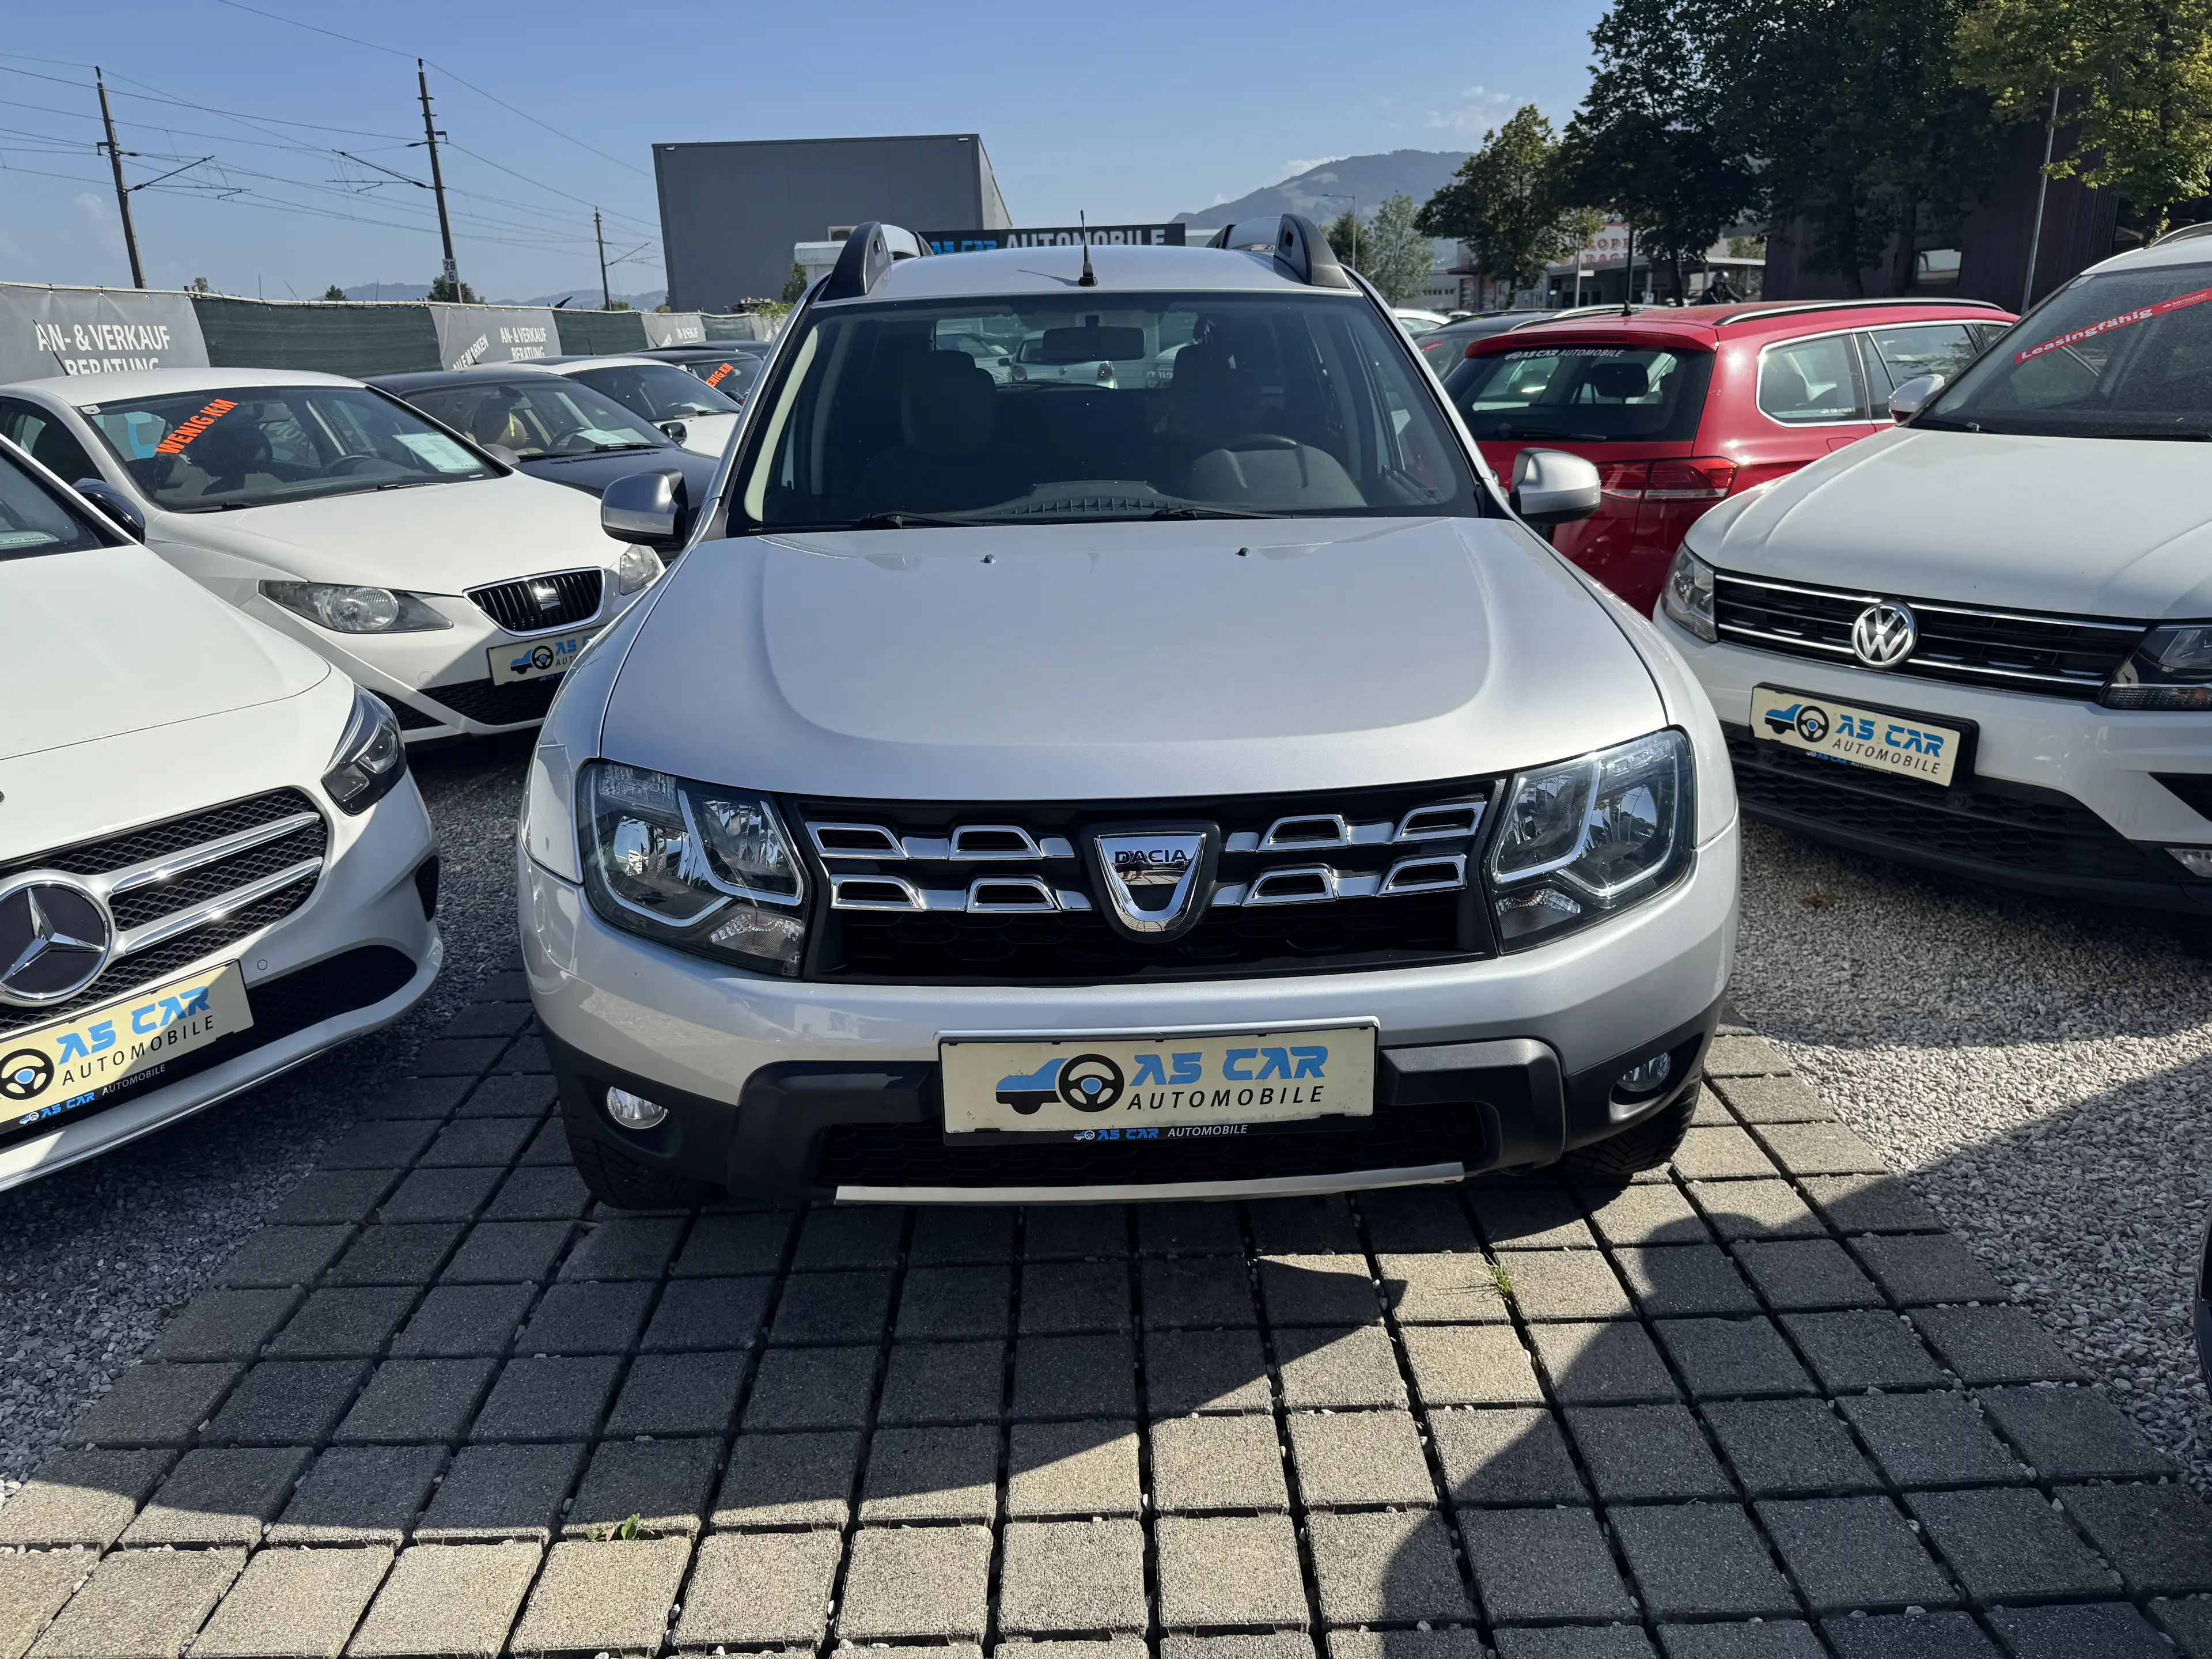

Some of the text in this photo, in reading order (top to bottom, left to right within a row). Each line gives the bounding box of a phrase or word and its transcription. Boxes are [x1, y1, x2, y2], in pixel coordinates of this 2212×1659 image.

[444, 261, 456, 271] 28
[449, 272, 454, 281] 6
[36, 324, 171, 351] AN- & VERKAUF
[500, 327, 547, 343] AN- & VERKAUF
[2021, 308, 2153, 360] Leasingfähig
[1557, 349, 1624, 357] AUTOMOBILE
[718, 362, 734, 374] KM
[154, 415, 215, 454] WENIG
[199, 399, 239, 417] KM
[555, 638, 577, 656] AS
[1835, 714, 1945, 758] AS CAR
[1832, 738, 1941, 775] AUTOMOBILE
[1115, 849, 1189, 864] DACIA
[56, 986, 211, 1065] AS CAR
[62, 1014, 214, 1086] AUTOMOBILE
[1129, 1046, 1328, 1086] AS CAR
[41, 1064, 166, 1119] AS CAR AUTOMOBILE
[1127, 1085, 1324, 1111] AUTOMOBILE
[1097, 1124, 1248, 1141] AS CAR AUTOMOBILE
